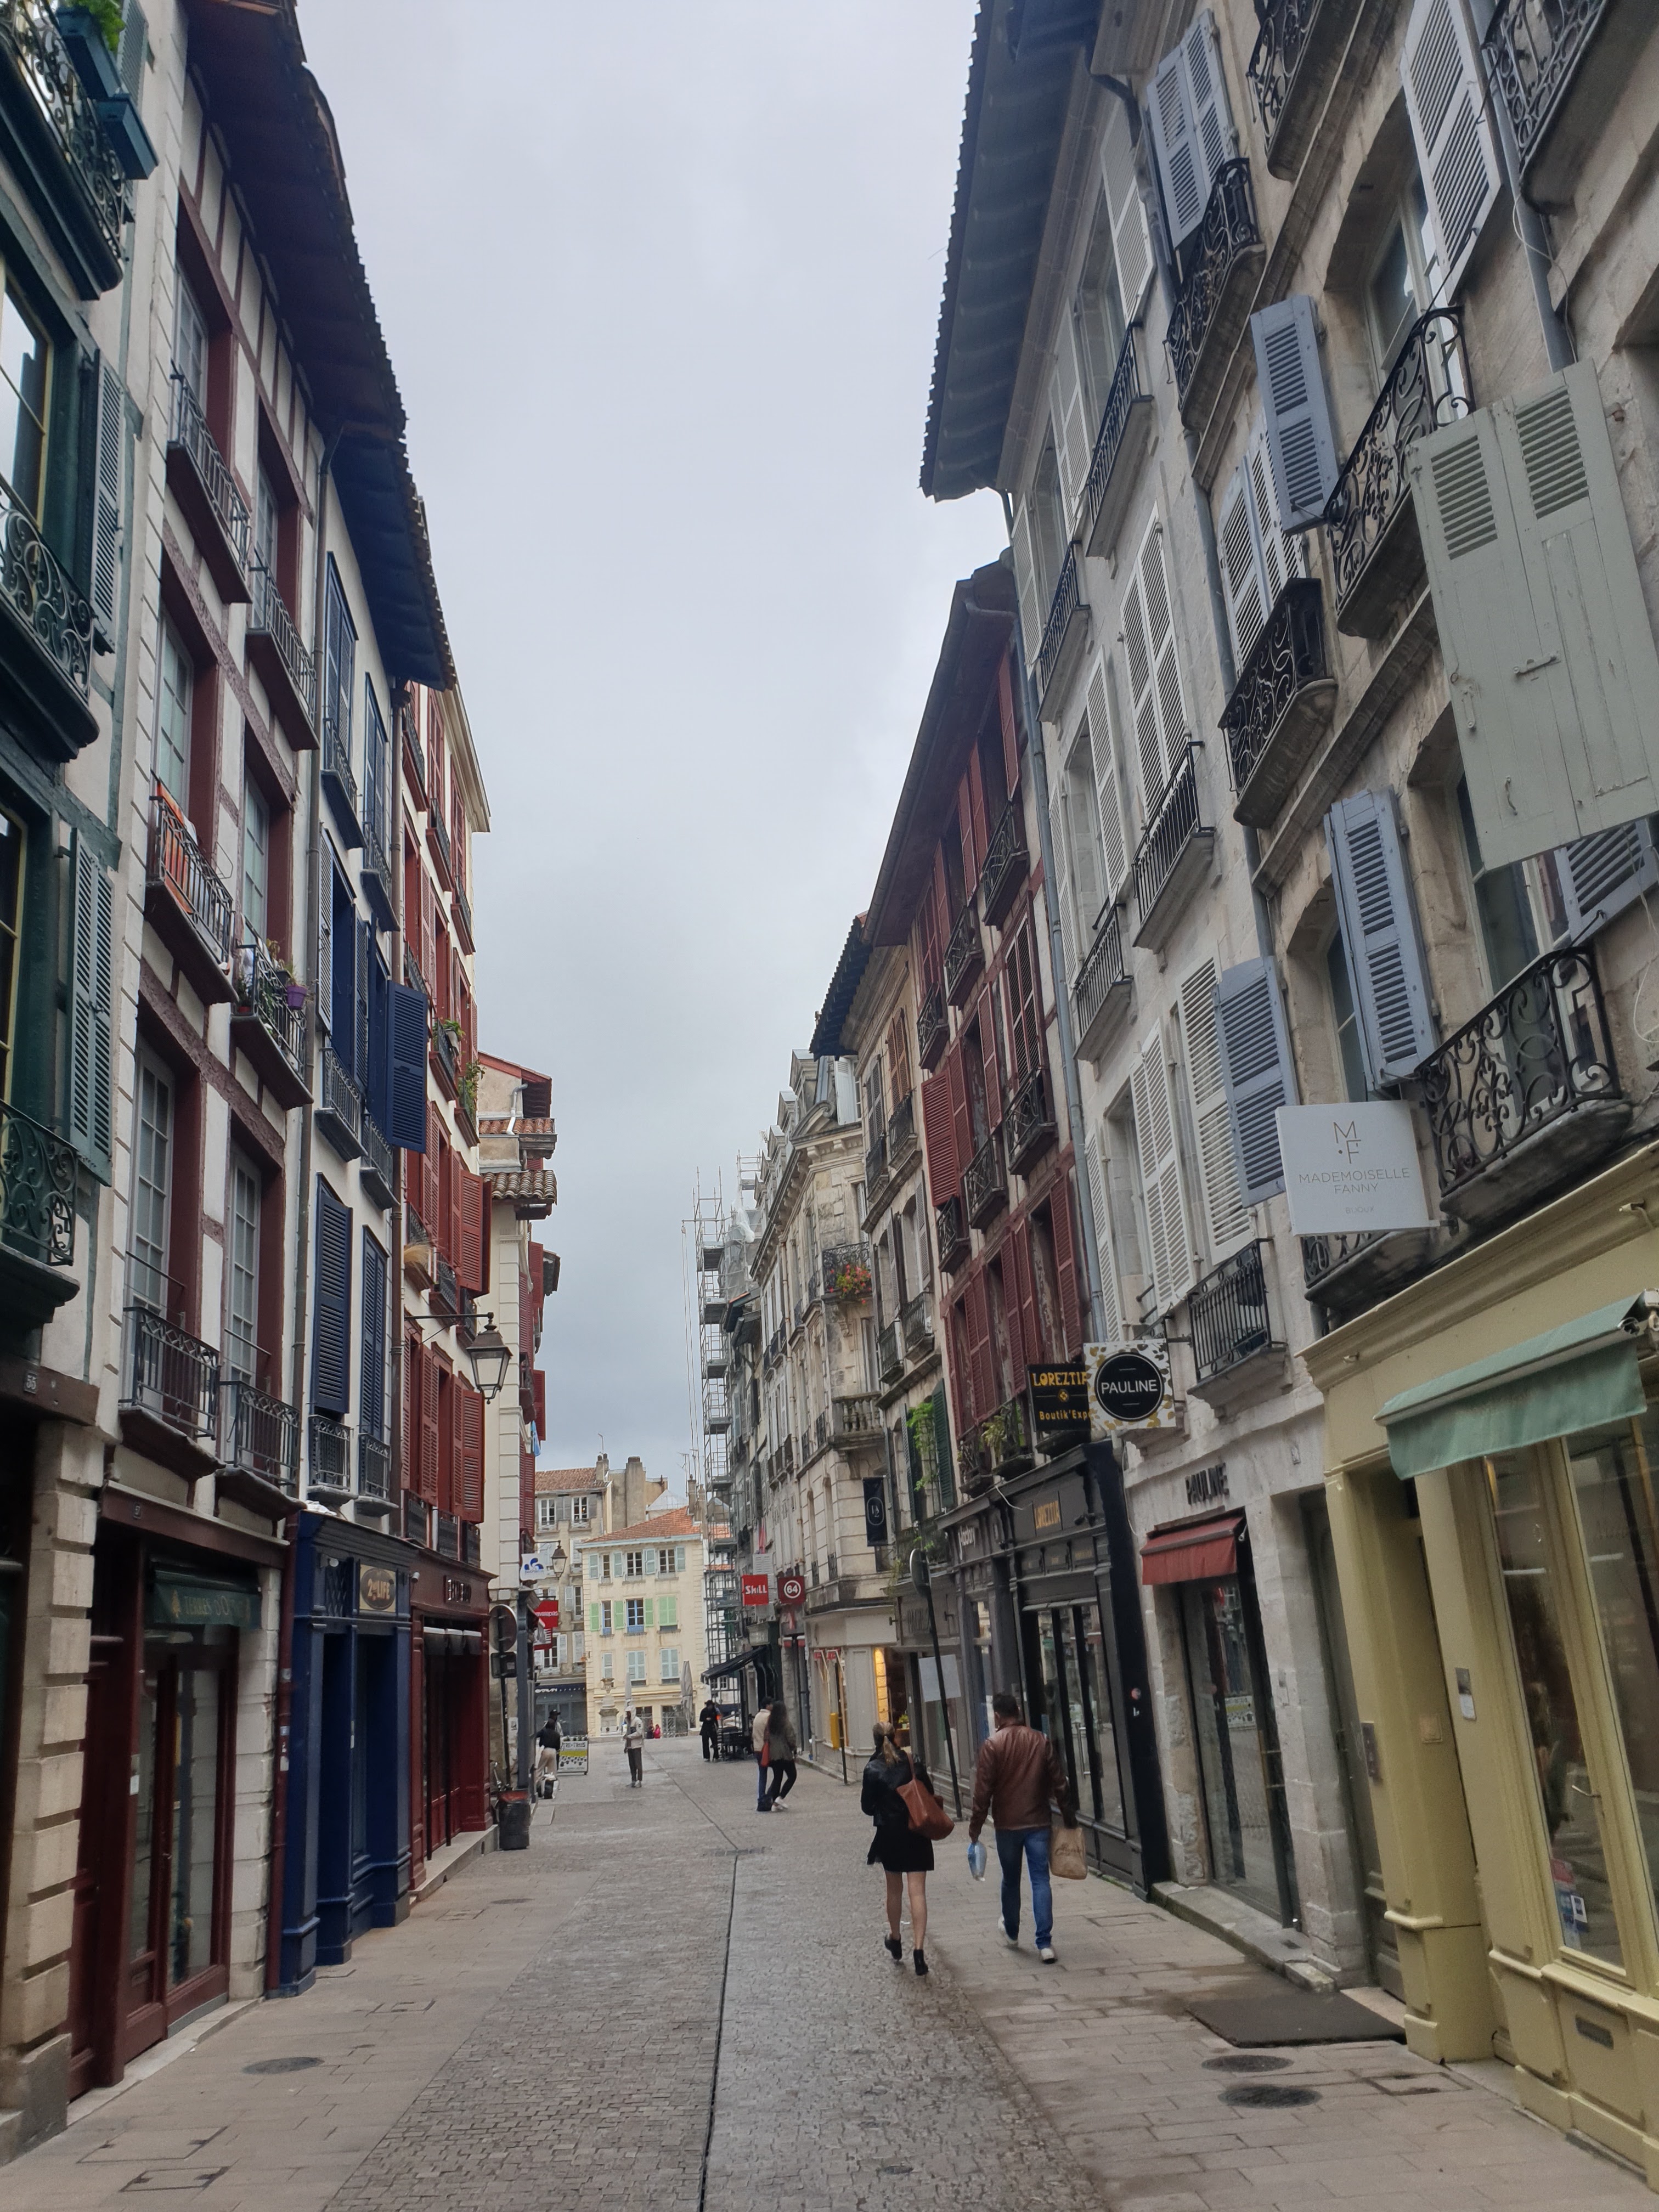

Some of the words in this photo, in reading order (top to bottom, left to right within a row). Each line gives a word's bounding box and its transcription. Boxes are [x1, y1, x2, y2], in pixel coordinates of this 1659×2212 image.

[1299, 1167, 1410, 1183] MADEMOISELLE
[1334, 1182, 1378, 1194] FANNY
[1345, 1206, 1374, 1214] BIJOUX
[1101, 1379, 1159, 1394] PAULINE
[1039, 1409, 1090, 1421] Boutik'Exp
[1185, 1462, 1229, 1505] PAULINE
[377, 1580, 391, 1600] LIFE
[787, 1584, 798, 1594] 64
